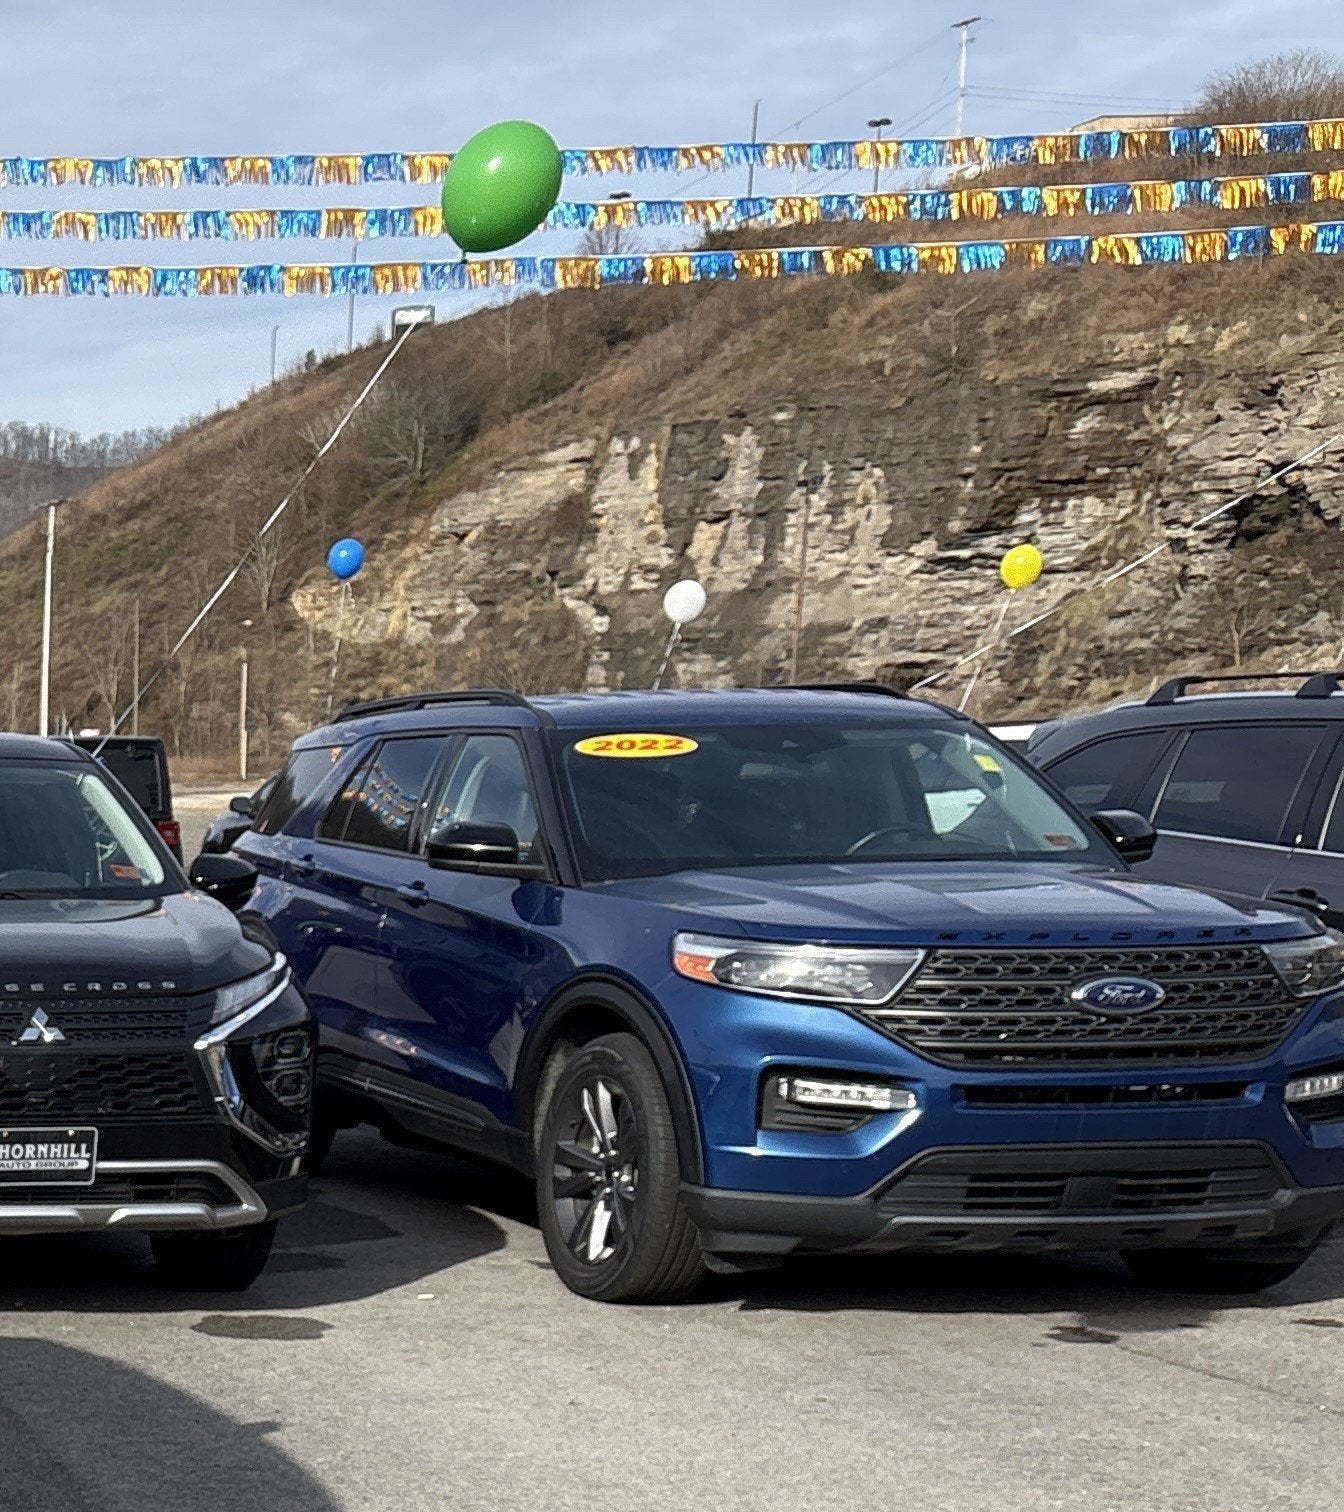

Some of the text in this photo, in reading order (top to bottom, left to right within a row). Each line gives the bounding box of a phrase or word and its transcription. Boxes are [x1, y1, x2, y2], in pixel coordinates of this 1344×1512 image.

[593, 739, 684, 751] 2022
[63, 981, 177, 992] CROSS
[1098, 984, 1147, 1005] Ford
